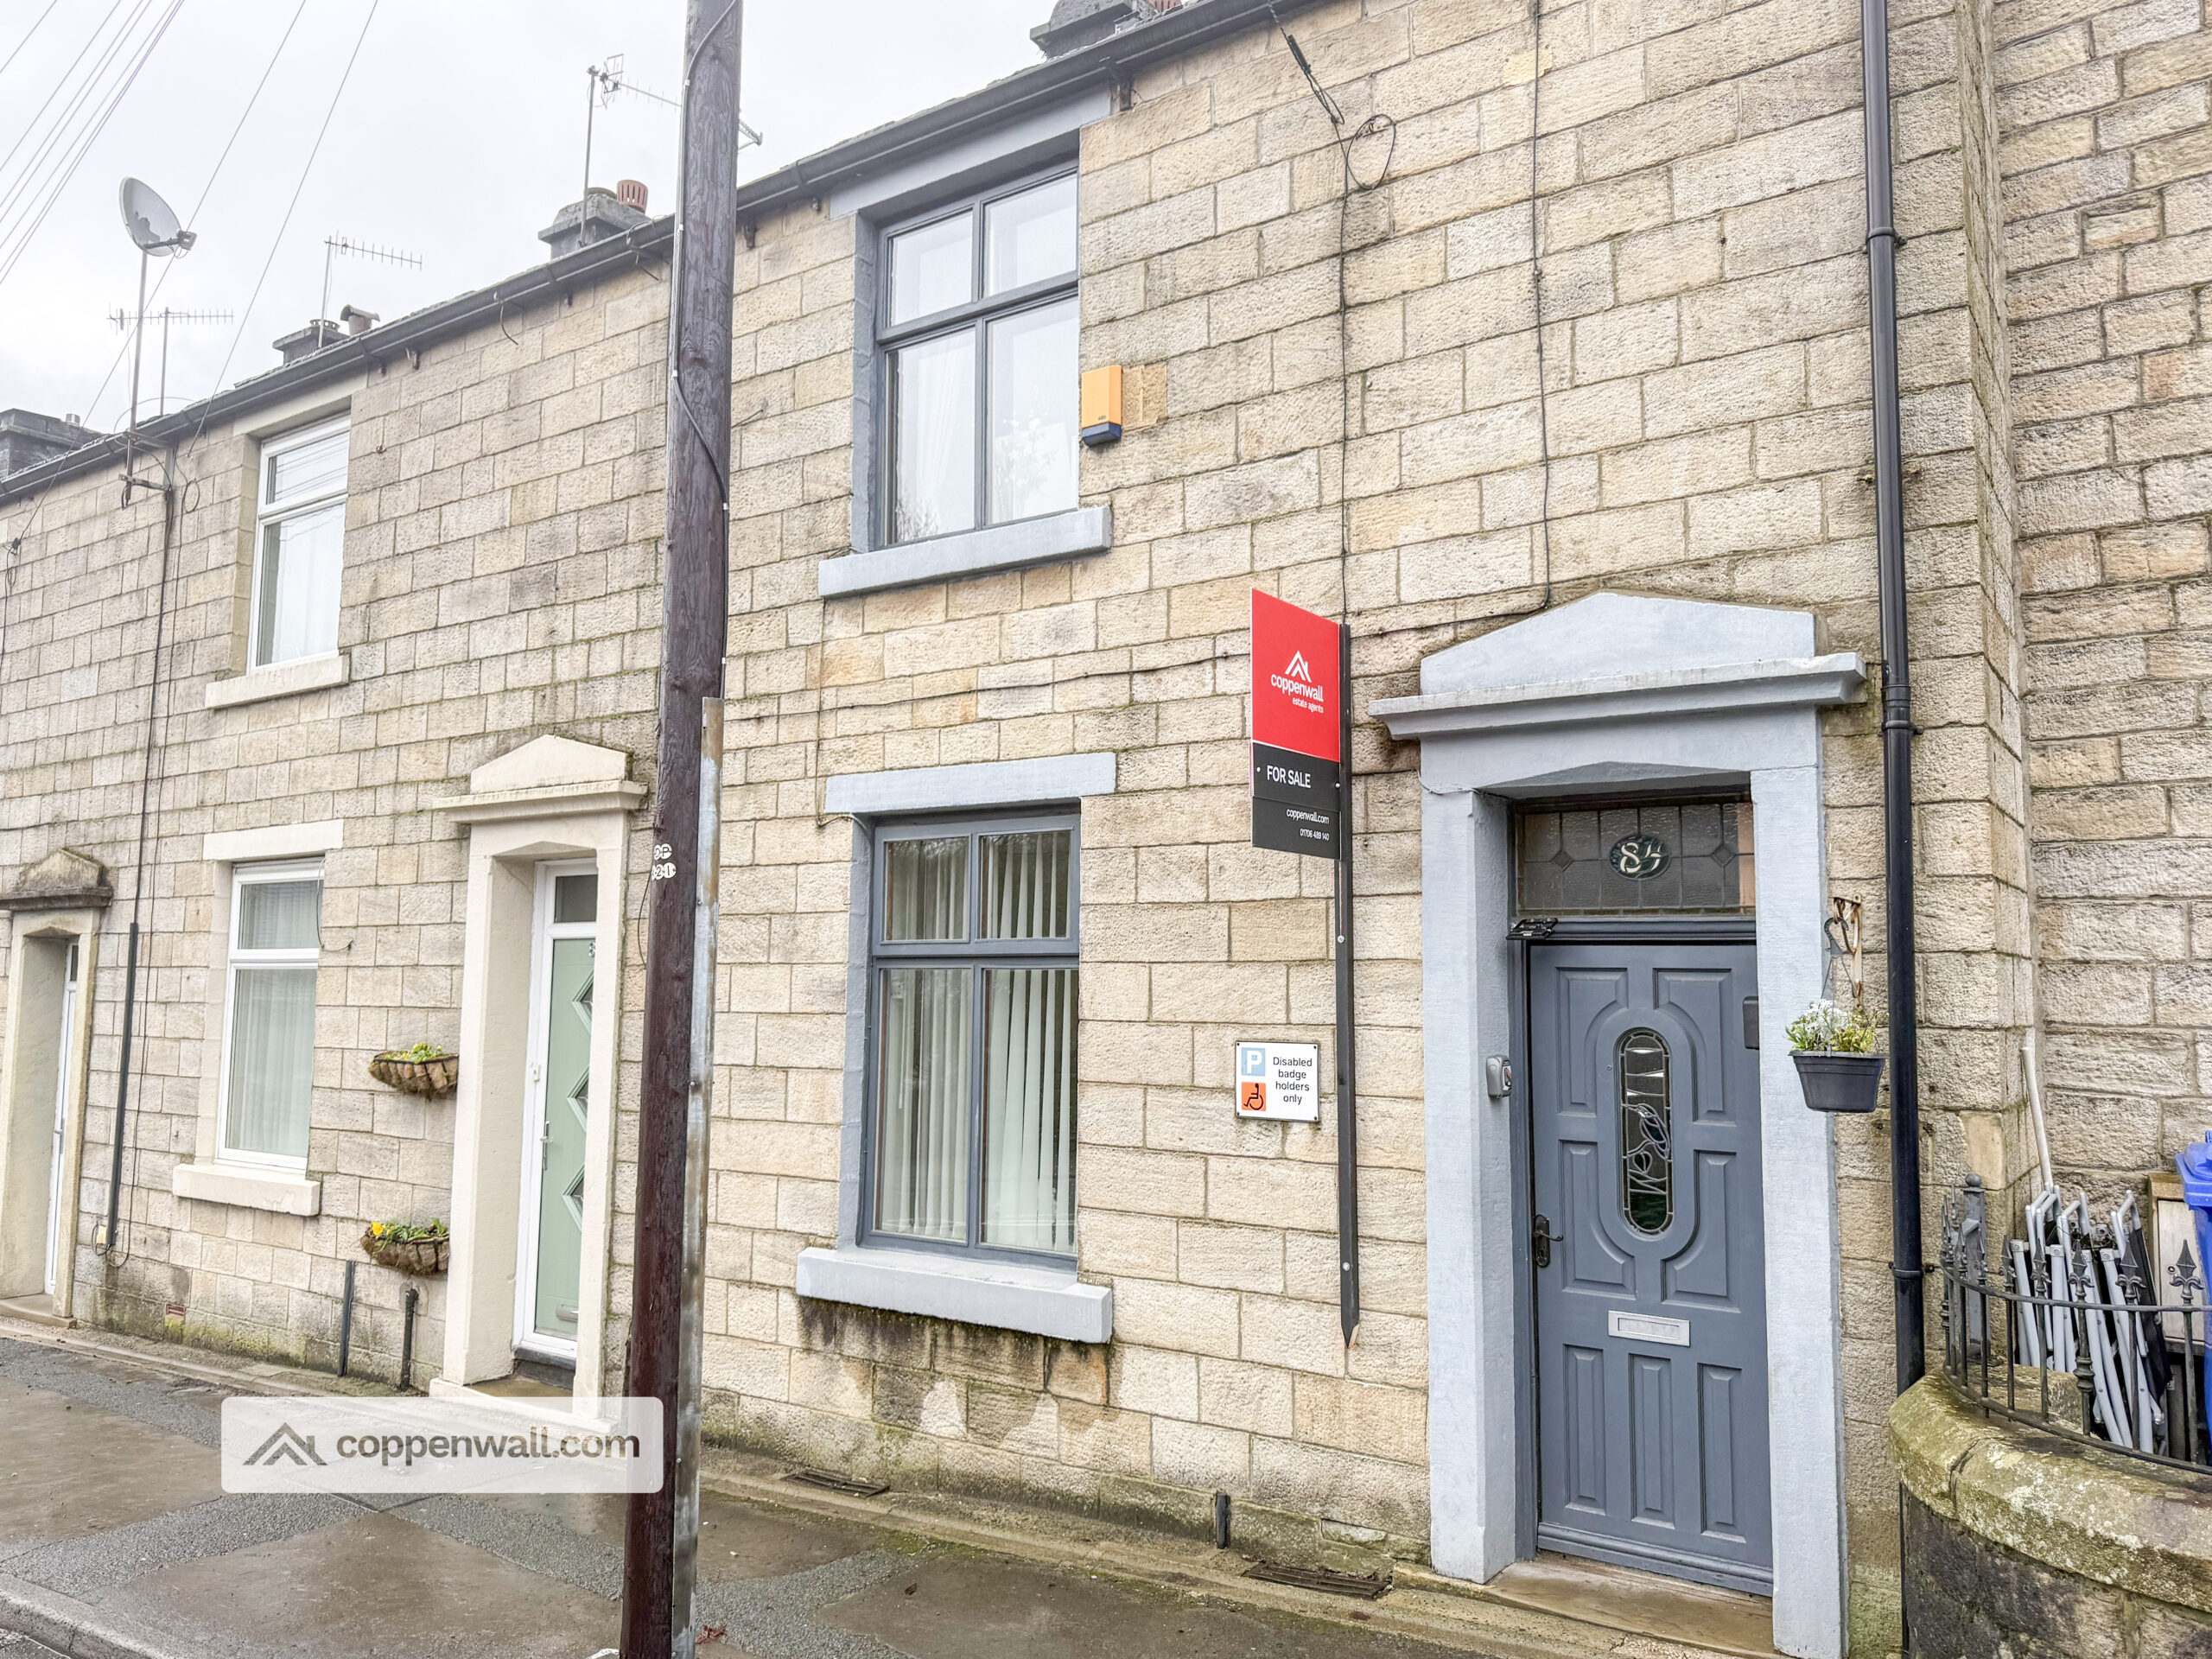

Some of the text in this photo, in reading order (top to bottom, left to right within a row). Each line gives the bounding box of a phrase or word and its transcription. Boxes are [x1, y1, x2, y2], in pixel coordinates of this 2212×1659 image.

[1271, 674, 1324, 702] coppenwall
[1292, 697, 1324, 714] estate agents
[1267, 765, 1312, 789] FOR SALE
[1286, 809, 1330, 824] coppenwall.com
[1620, 842, 1662, 873] 84
[1273, 1057, 1313, 1067] Disabled
[1278, 1069, 1306, 1081] badge
[1275, 1081, 1310, 1091] holders
[1283, 1094, 1302, 1105] only
